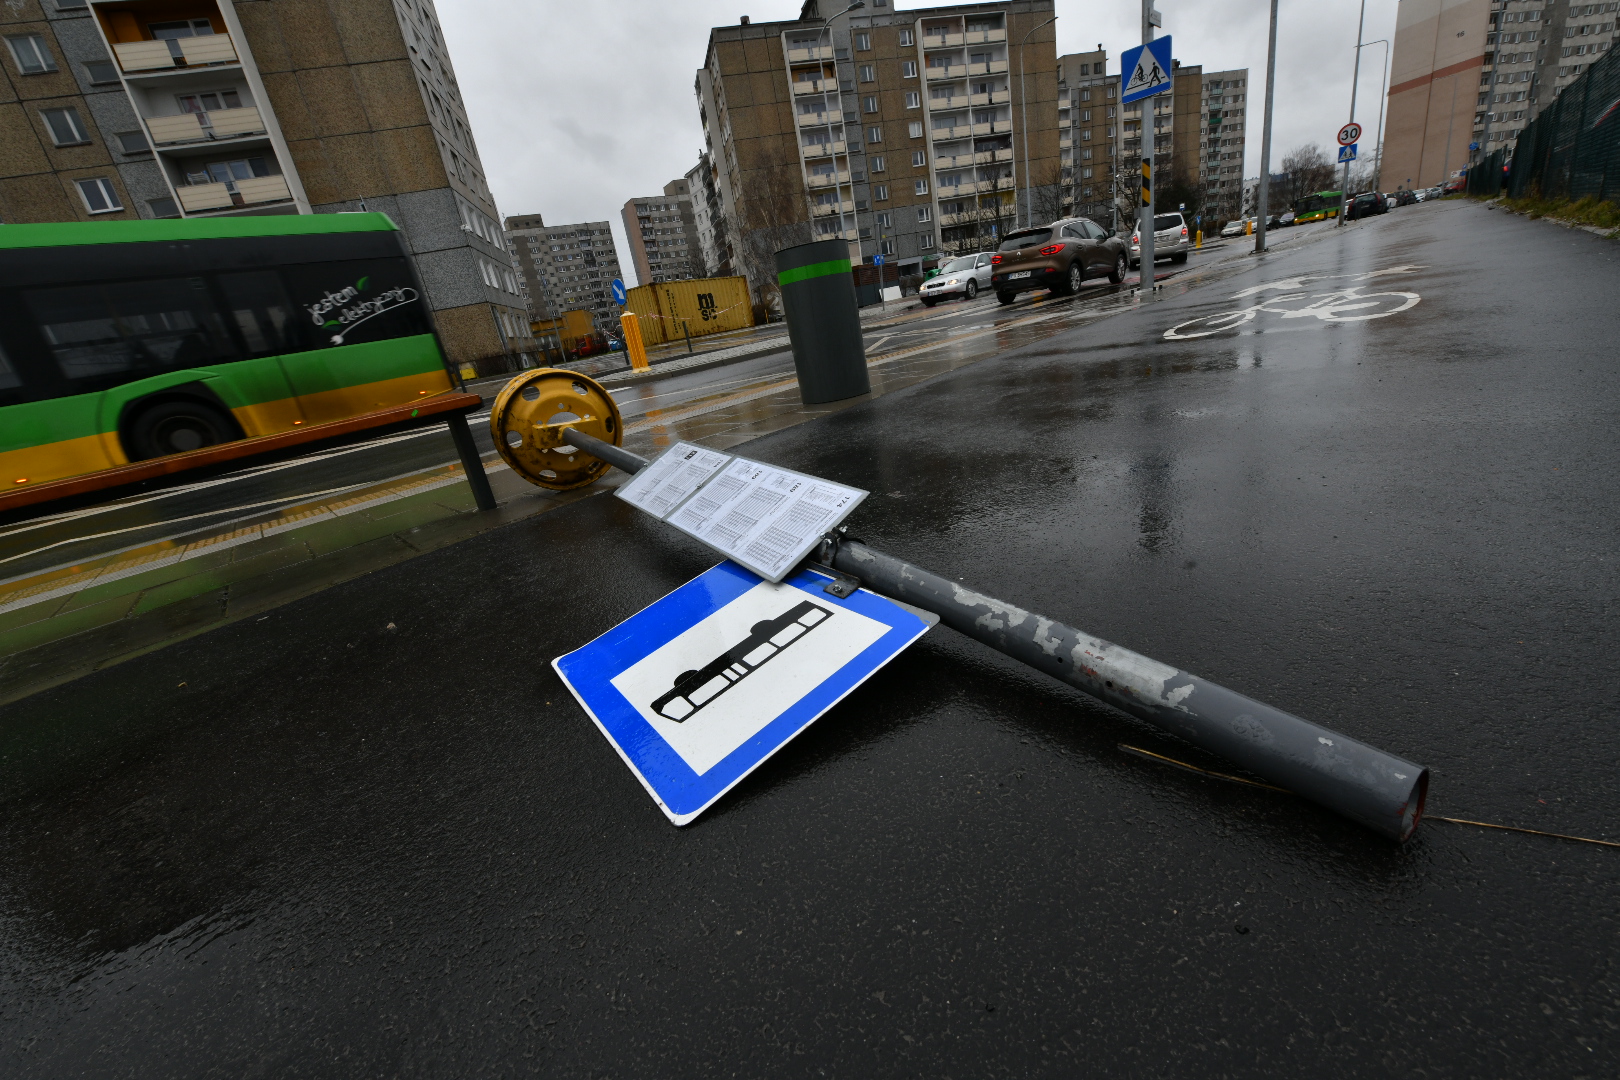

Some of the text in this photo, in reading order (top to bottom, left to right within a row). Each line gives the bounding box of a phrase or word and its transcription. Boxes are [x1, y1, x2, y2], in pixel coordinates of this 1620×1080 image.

[1341, 127, 1358, 141] 30
[302, 286, 359, 326] jestem
[338, 286, 414, 324] elektryczny
